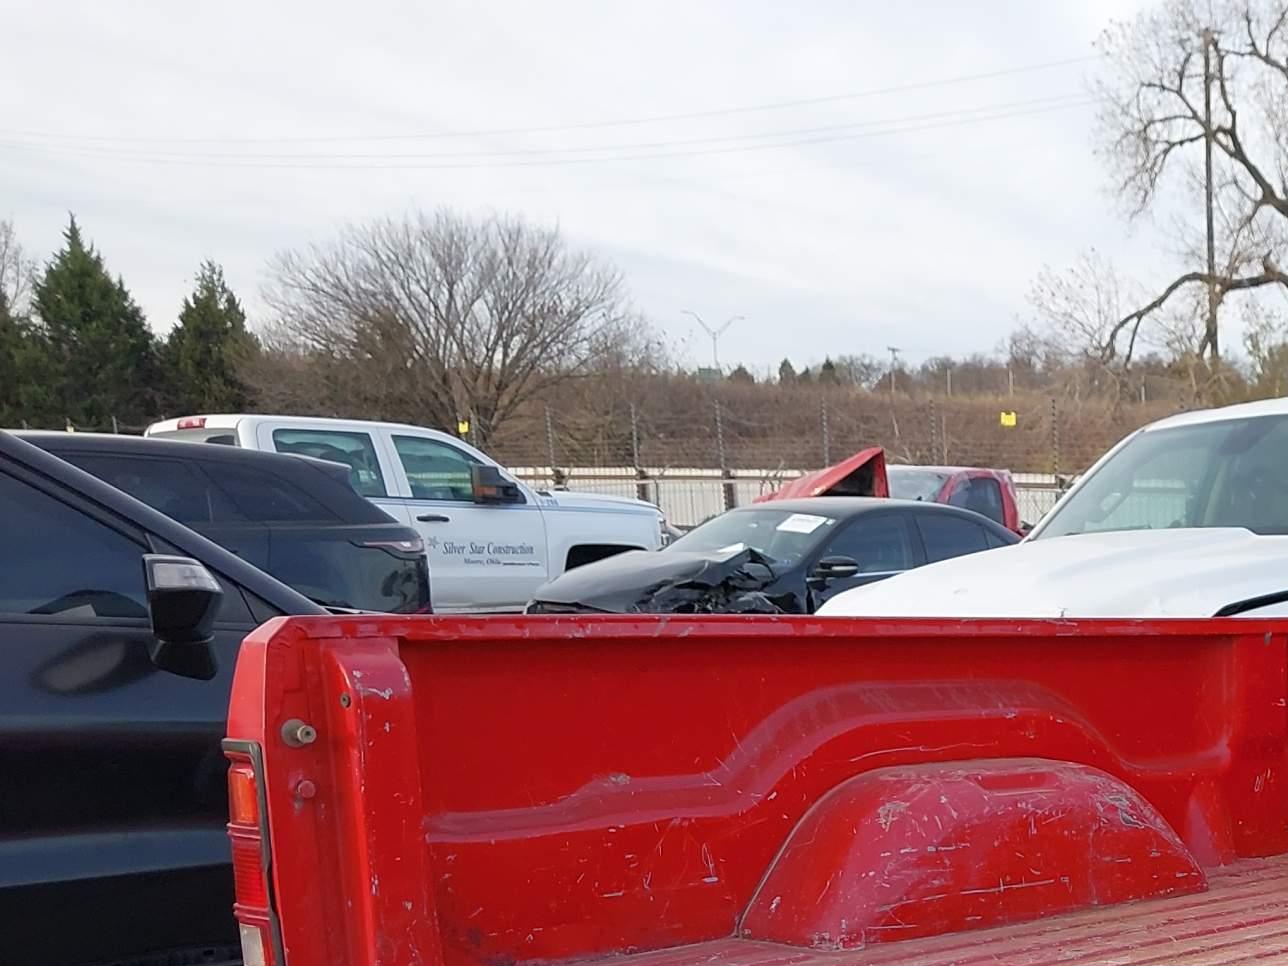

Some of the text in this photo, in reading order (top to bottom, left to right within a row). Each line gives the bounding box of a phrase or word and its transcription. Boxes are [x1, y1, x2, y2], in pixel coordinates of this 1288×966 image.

[443, 541, 535, 555] Silver Star Construction
